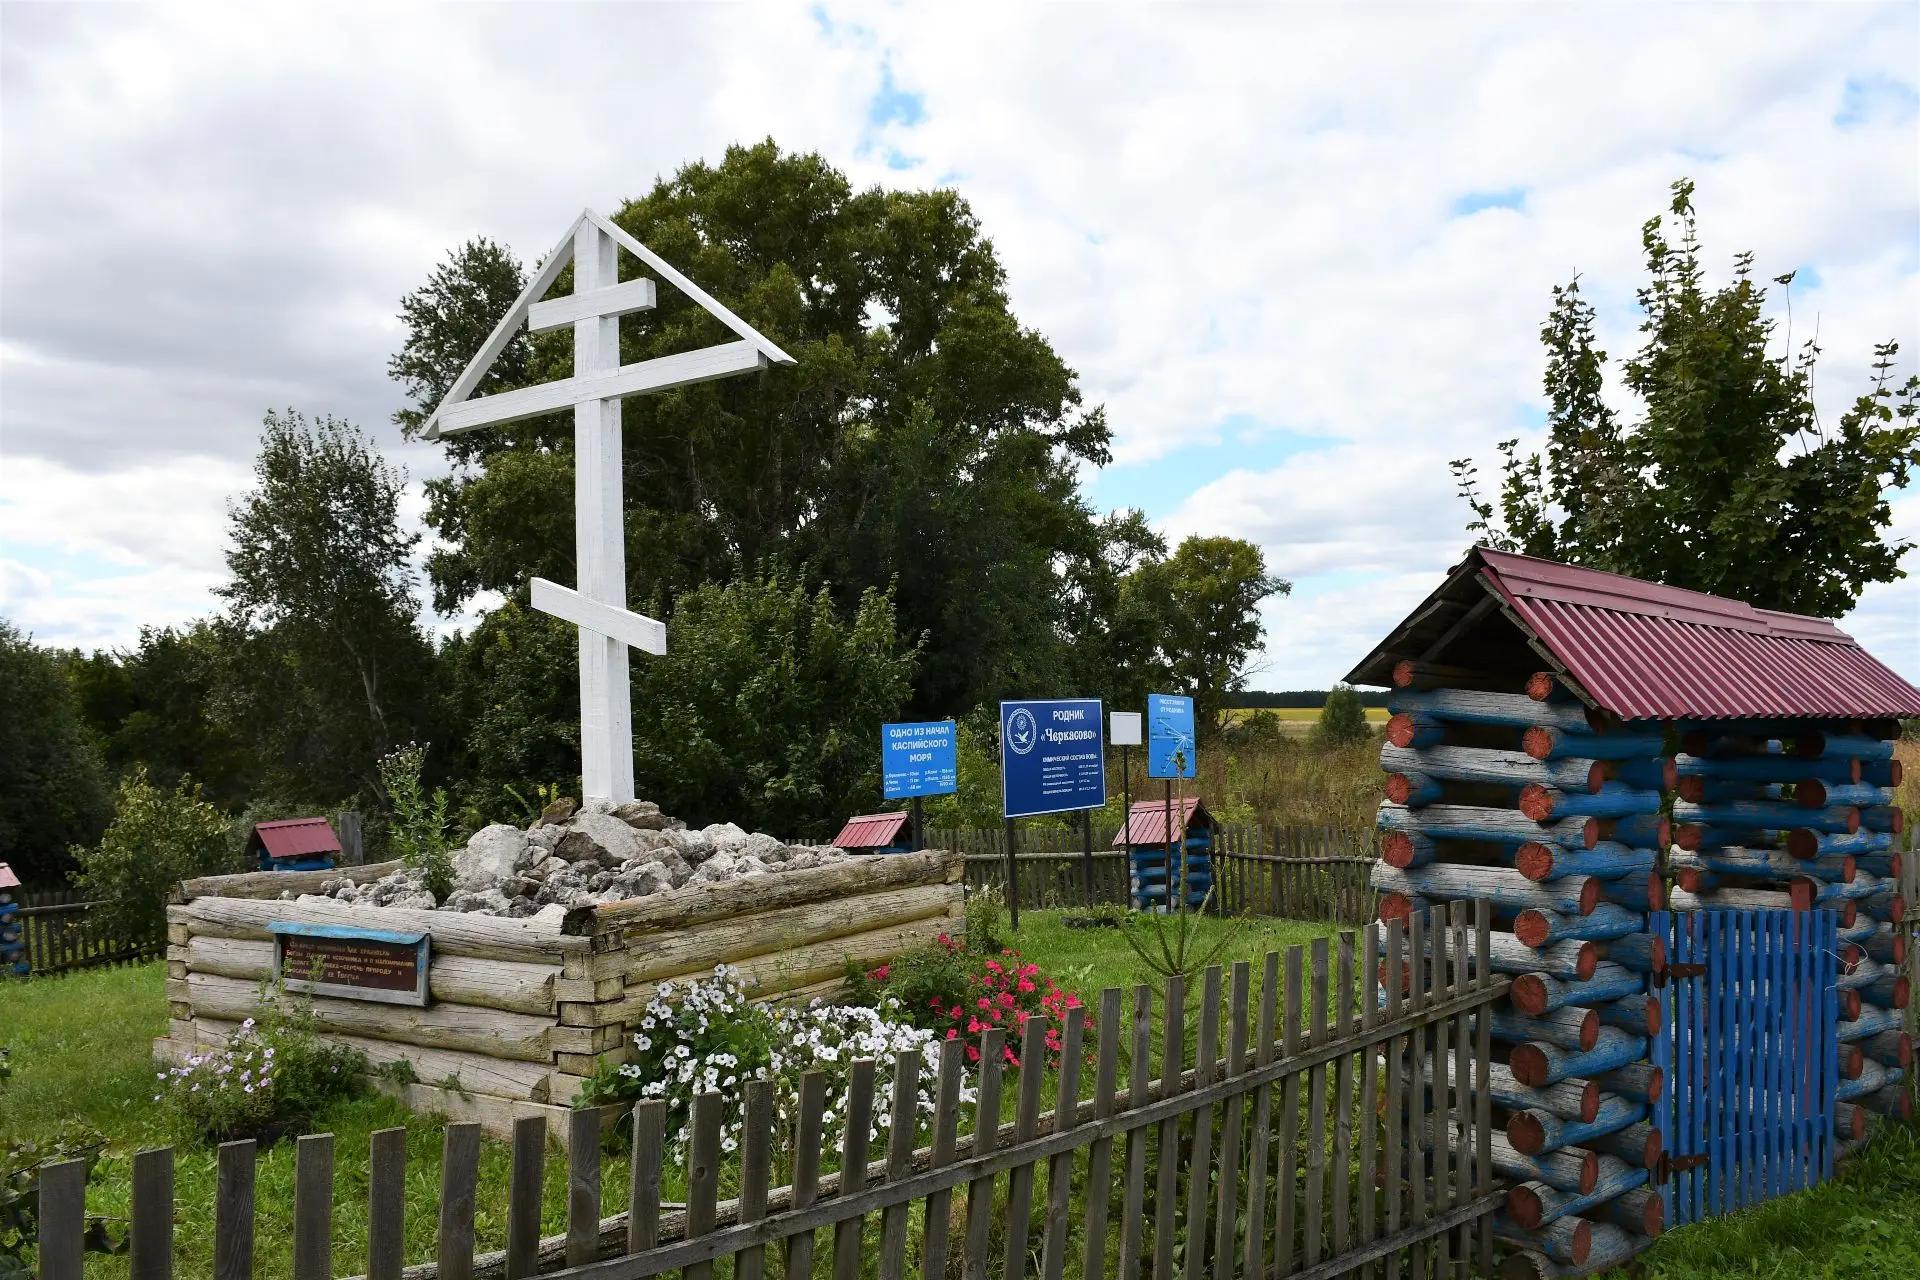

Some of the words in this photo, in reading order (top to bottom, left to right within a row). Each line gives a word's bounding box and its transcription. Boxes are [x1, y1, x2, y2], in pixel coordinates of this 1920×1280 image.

[1053, 709, 1085, 722] РОДНИК
[889, 728, 913, 738] ОДНО
[914, 727, 925, 736] ИЗ
[926, 726, 950, 735] НАЧАЛ
[1040, 728, 1097, 745] «Черкасово»
[892, 738, 948, 750] КАСПИЙСКОГО
[909, 753, 932, 762] МОРЯ
